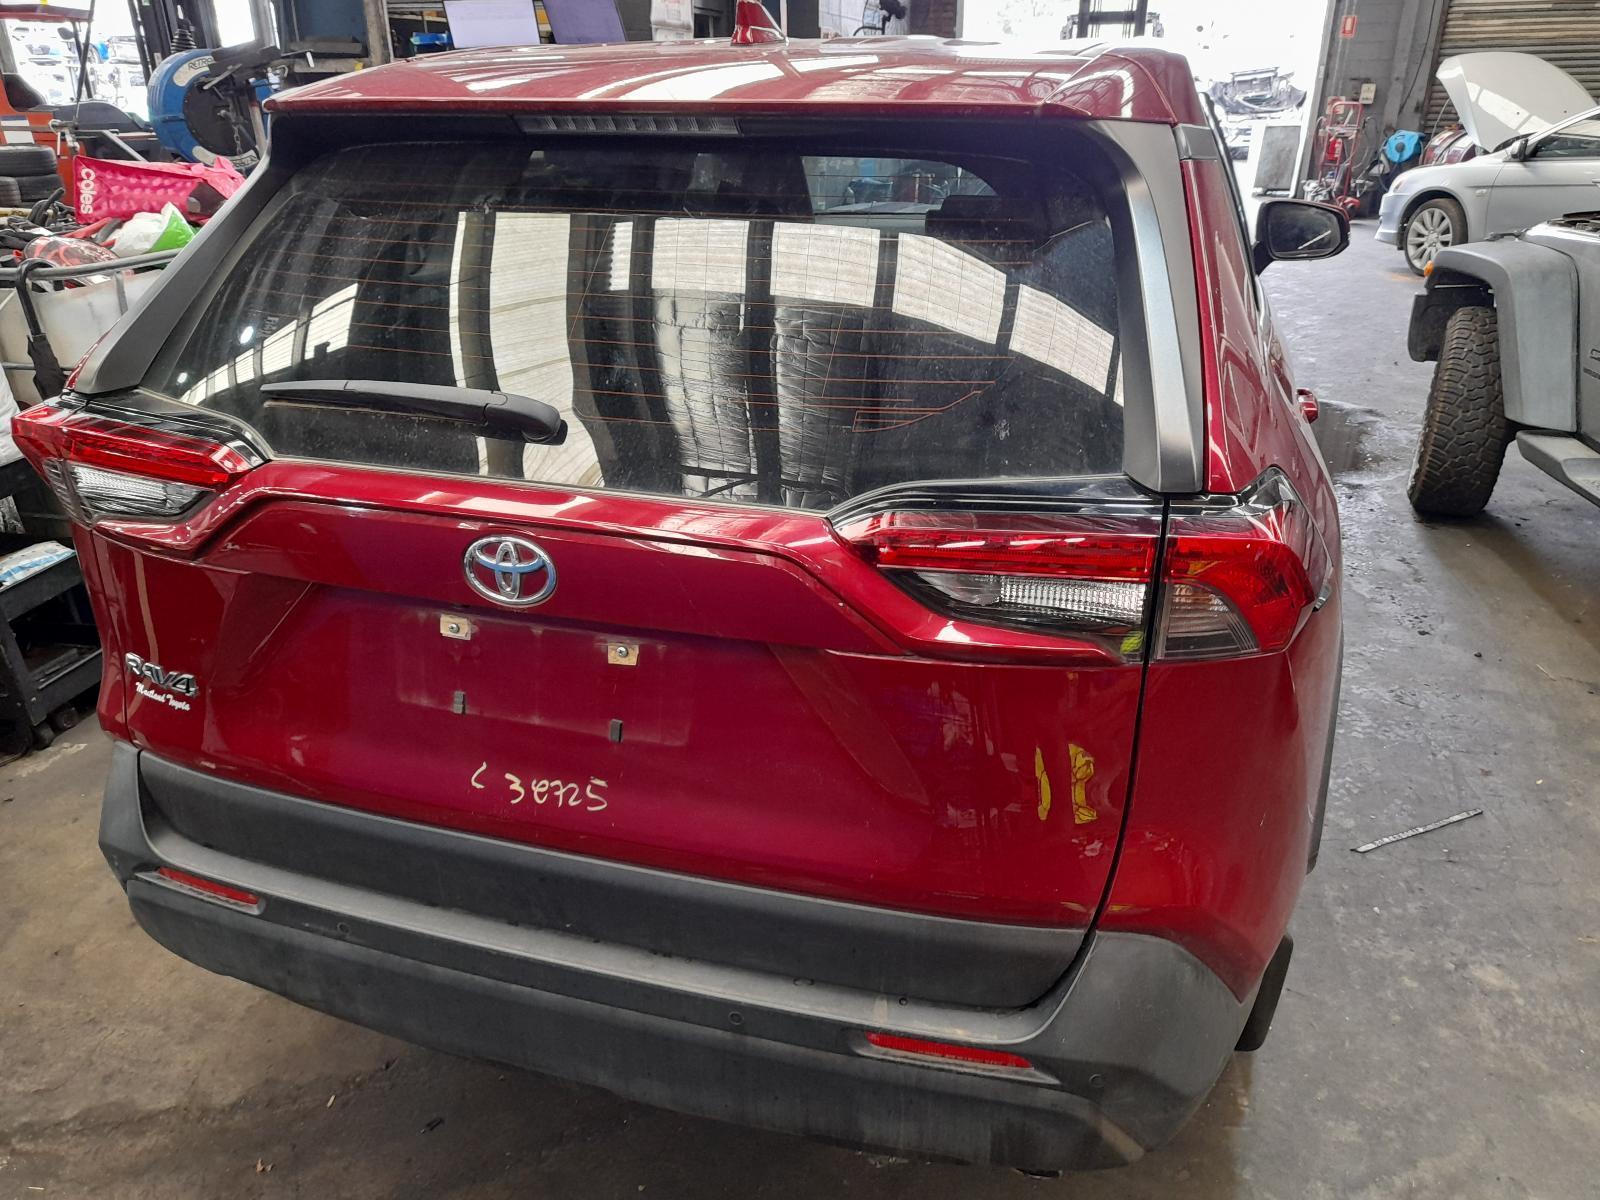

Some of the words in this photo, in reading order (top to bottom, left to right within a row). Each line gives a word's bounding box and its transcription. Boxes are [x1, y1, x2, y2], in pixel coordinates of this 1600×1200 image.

[80, 168, 97, 214] coles
[125, 652, 200, 698] RAV4
[166, 693, 191, 711] Toyota
